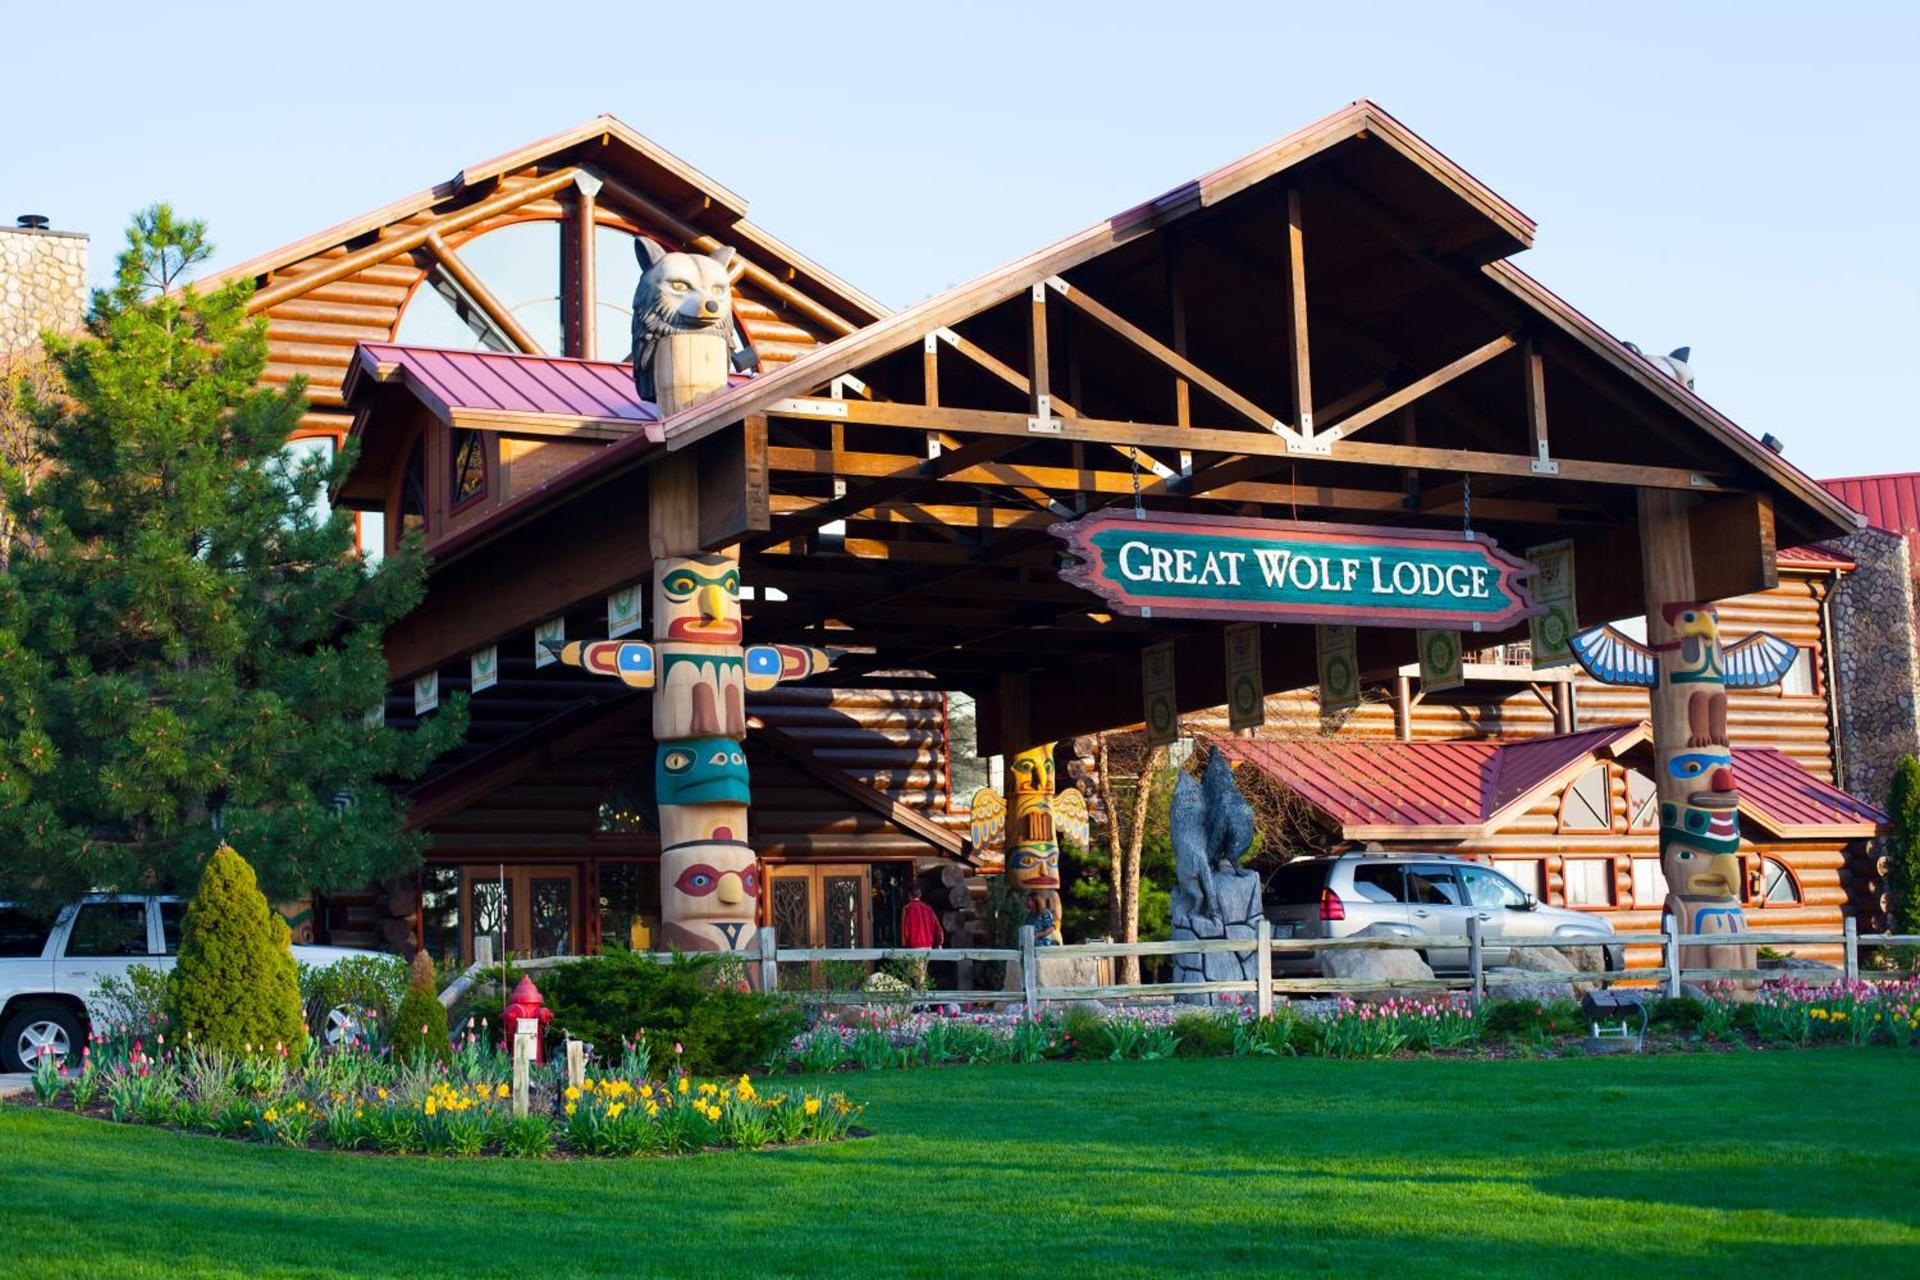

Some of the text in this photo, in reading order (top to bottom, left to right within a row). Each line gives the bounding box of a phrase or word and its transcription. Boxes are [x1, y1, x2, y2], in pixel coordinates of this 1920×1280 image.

[1119, 541, 1245, 586] GREAT
[1253, 548, 1360, 592] WOLF
[1370, 556, 1490, 598] LODGE
